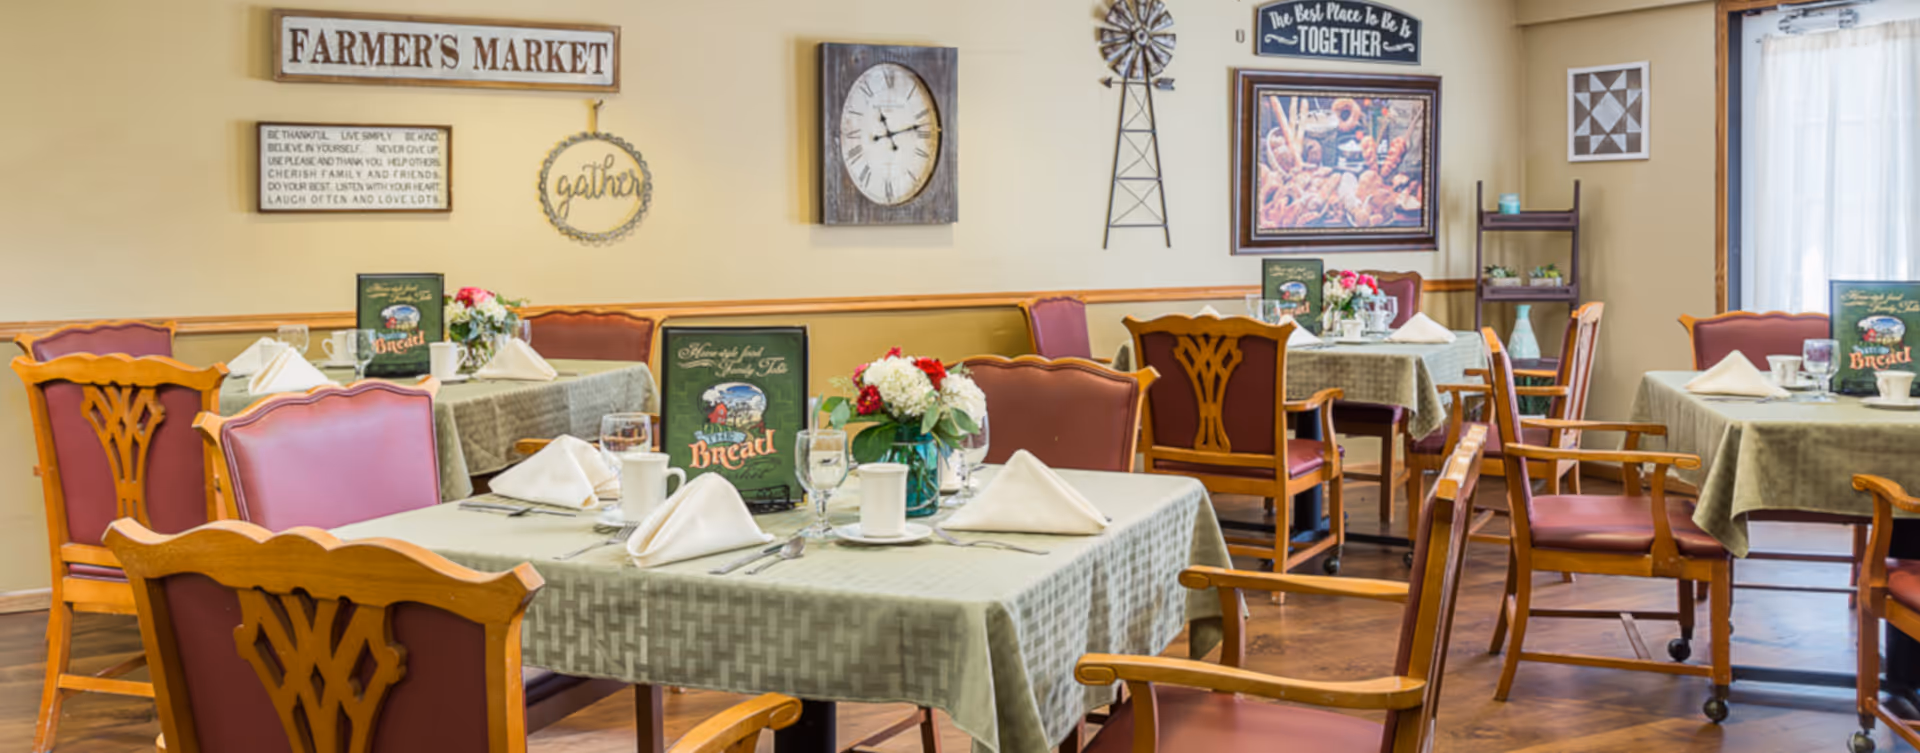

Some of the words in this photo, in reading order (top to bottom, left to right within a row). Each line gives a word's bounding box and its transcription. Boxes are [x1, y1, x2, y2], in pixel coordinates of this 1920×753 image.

[1268, 11, 1293, 30] The
[1293, 3, 1324, 22] Best
[1326, 2, 1362, 23] Place
[1364, 6, 1379, 26] To
[1381, 11, 1398, 33] Be
[1400, 18, 1412, 39] Is
[289, 28, 460, 69] FARMER'S
[472, 36, 608, 75] MARKET
[1297, 25, 1381, 57] TOGETHER
[268, 169, 317, 179] CHERISH
[321, 169, 362, 179] FAMILY
[368, 170, 389, 179] AND
[556, 153, 640, 222] gather
[268, 194, 306, 205] LAUGH
[310, 194, 348, 205] OFTEN
[353, 194, 374, 205] AND
[378, 194, 407, 205] LOVE
[373, 331, 425, 354] Bread
[1849, 346, 1912, 371] Bread
[688, 429, 777, 470] Bread
